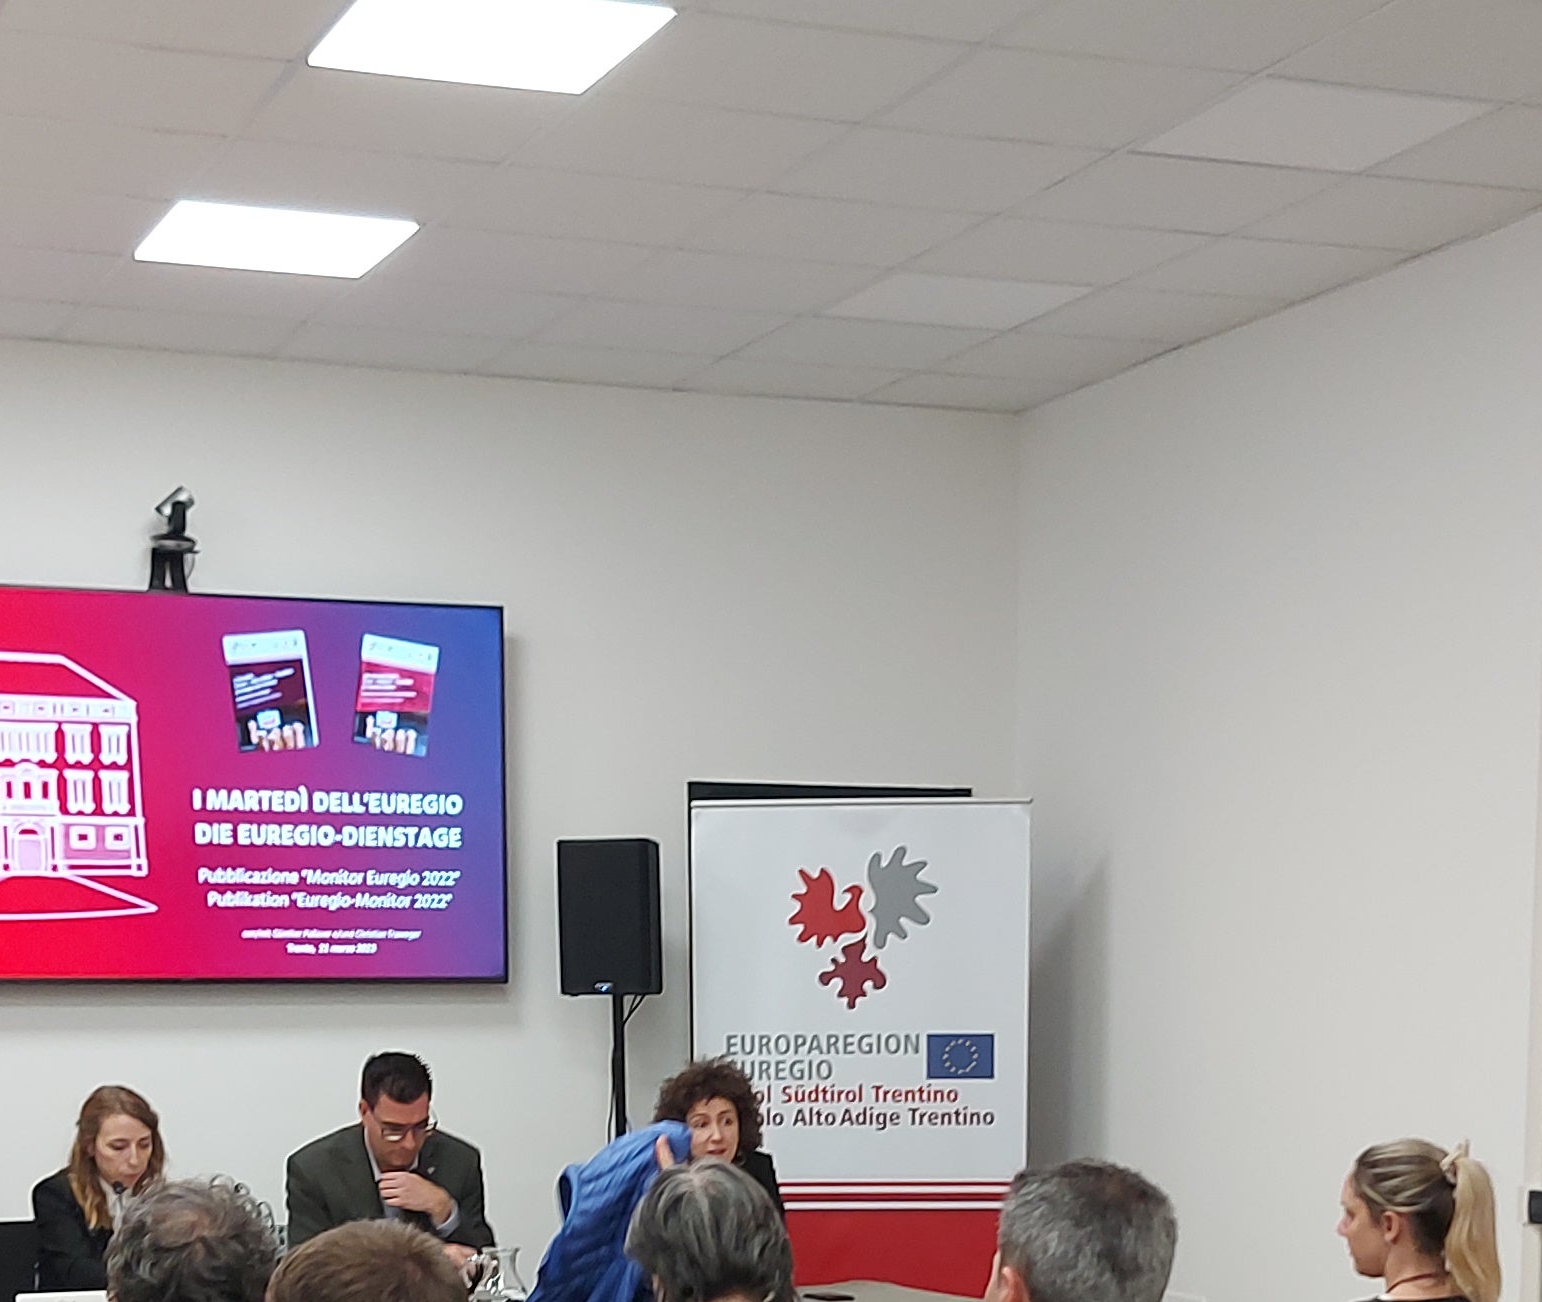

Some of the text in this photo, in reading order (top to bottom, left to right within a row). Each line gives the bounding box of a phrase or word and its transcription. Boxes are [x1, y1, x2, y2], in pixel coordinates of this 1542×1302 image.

[193, 785, 464, 815] I MARTEDÌ DELL'EUREGIO
[194, 822, 463, 848] DIE EUREGIO-DIENSTAGE
[198, 867, 300, 885] Pubblicazione
[366, 869, 420, 889] Euregio
[207, 890, 290, 908] Publikation
[725, 1033, 920, 1056] EUROPAREGION
[781, 1083, 863, 1103] Südtirol
[871, 1084, 958, 1103] Trentino
[792, 1107, 836, 1127] Alto
[841, 1107, 901, 1131] Adige
[909, 1106, 995, 1126] Trentino
